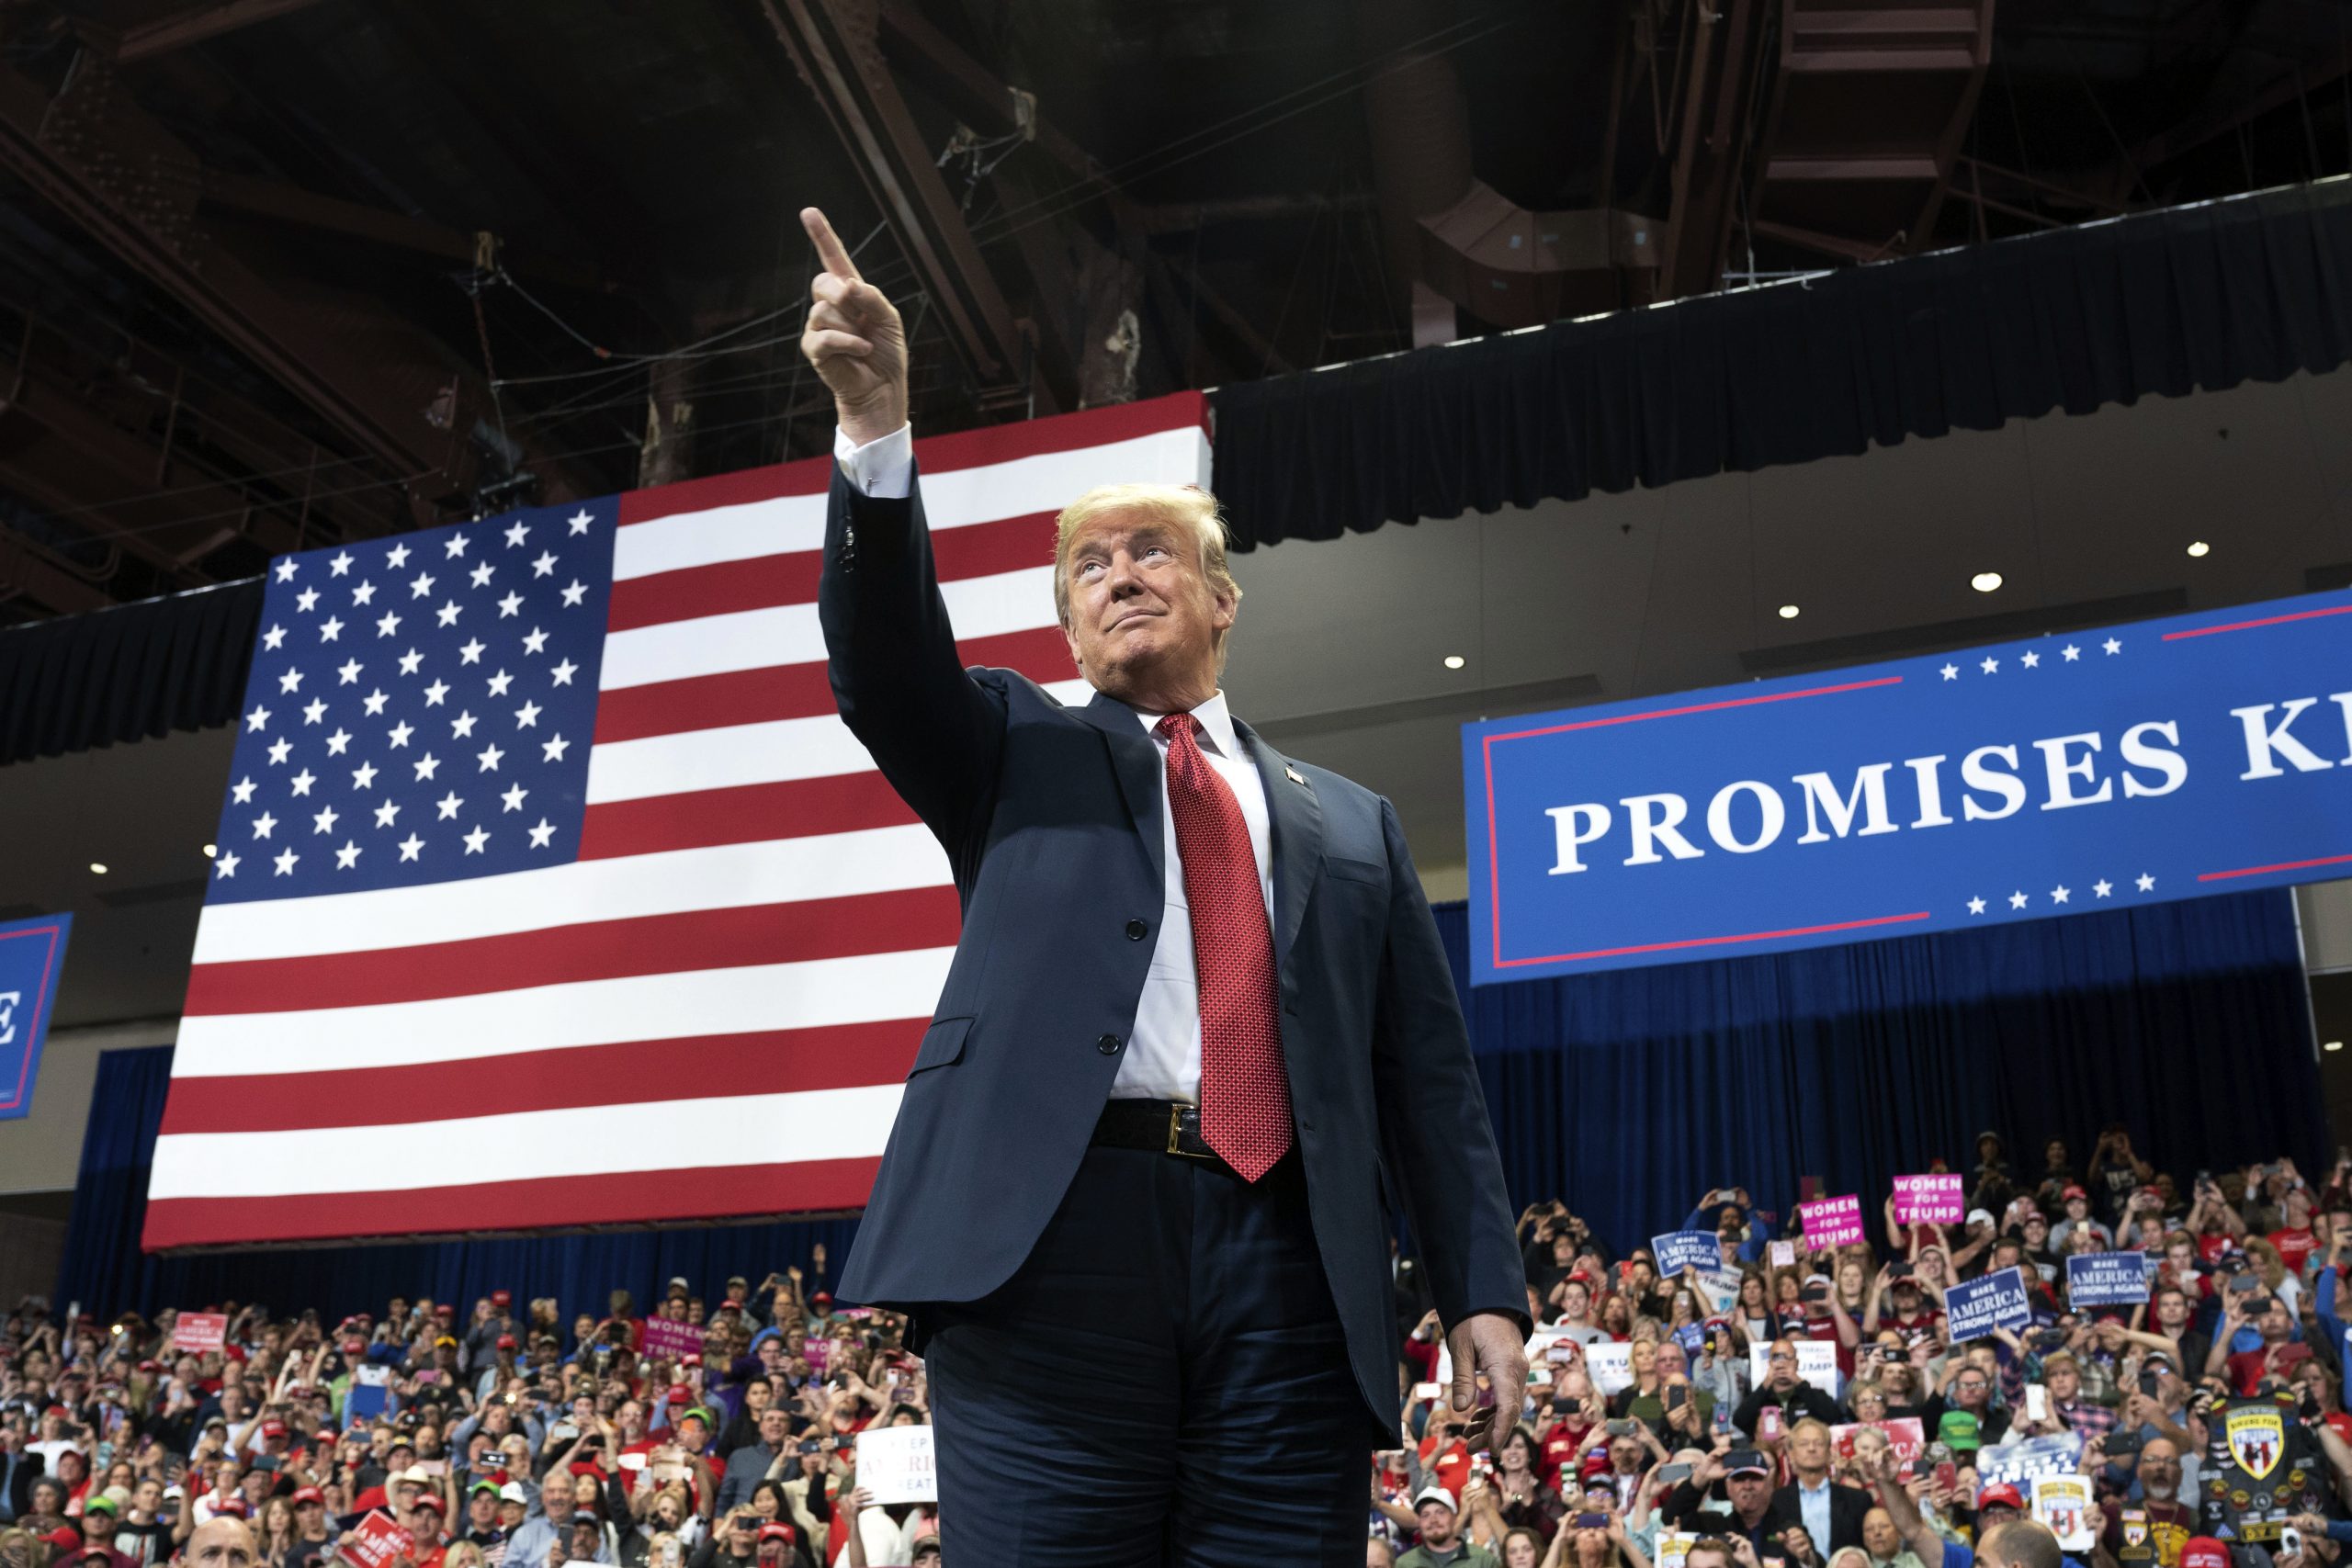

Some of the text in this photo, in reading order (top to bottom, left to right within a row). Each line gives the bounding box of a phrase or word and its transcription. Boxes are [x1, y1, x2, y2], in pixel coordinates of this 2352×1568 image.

[1545, 720, 2188, 876] PROMISES
[1894, 1178, 1962, 1191] WOMEN
[1914, 1195, 1939, 1203] FOR
[1801, 1198, 1860, 1219] WOMEN
[1898, 1207, 1959, 1221] TRUMP
[1819, 1217, 1841, 1229] FOR
[1808, 1227, 1860, 1247] TRUMP
[1659, 1244, 1721, 1261] AMERICA
[2072, 1269, 2145, 1286] AMERICA
[1951, 1288, 2024, 1322] AMERICA
[1951, 1313, 1994, 1334] STRONG
[1994, 1303, 2028, 1322] AGAIN
